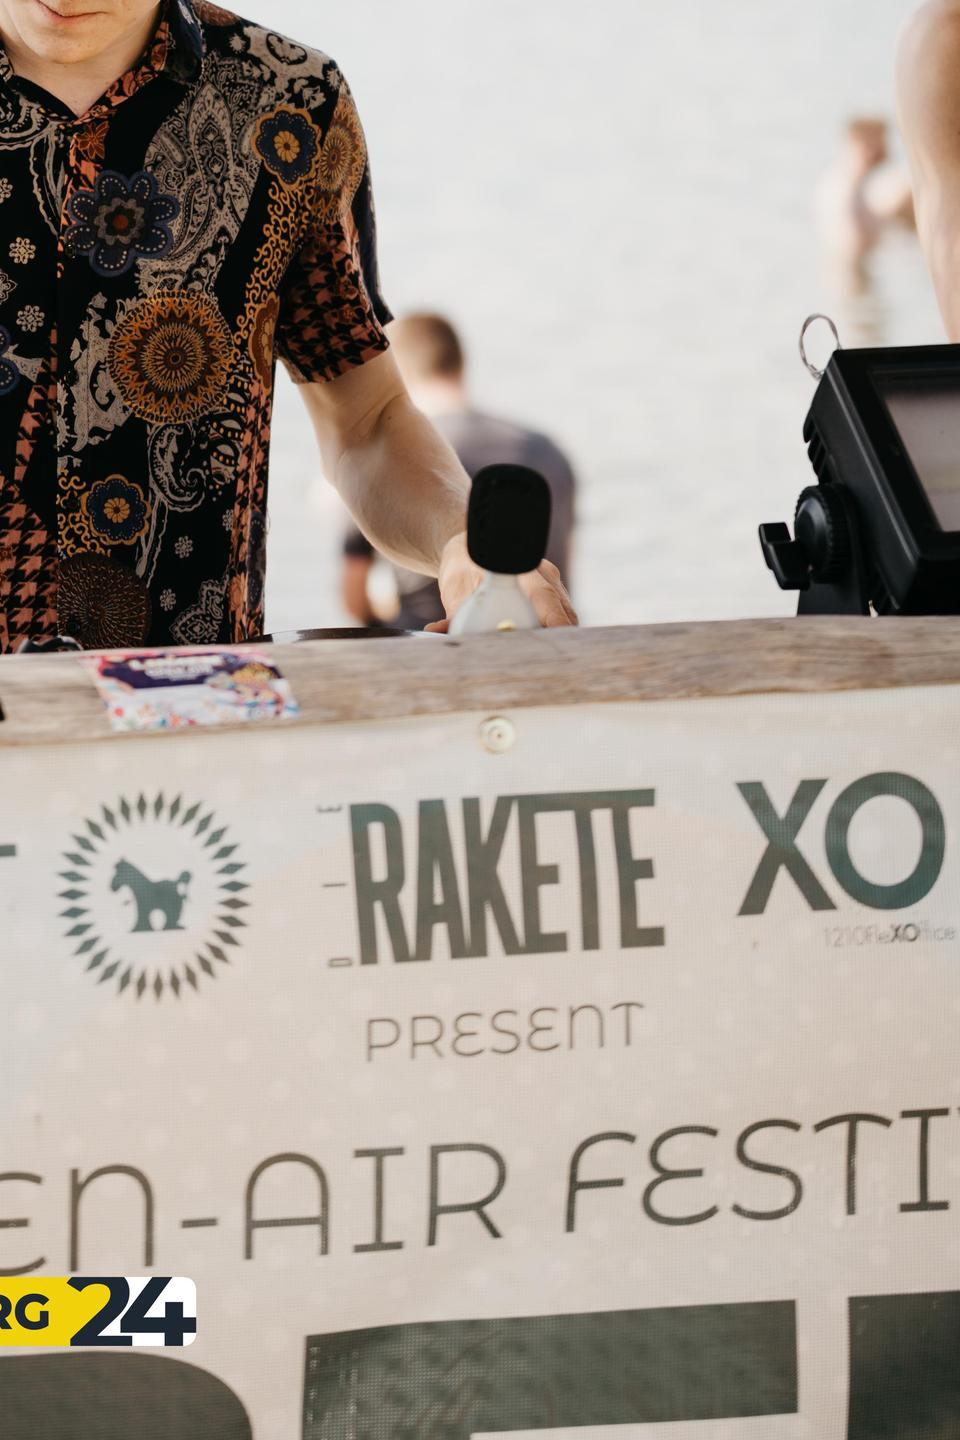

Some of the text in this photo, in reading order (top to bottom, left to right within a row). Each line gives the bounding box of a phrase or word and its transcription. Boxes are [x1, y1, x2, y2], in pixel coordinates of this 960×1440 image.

[349, 788, 665, 965] RAKETE
[735, 771, 946, 916] XO
[366, 1001, 644, 1061] PRESENT
[565, 1107, 960, 1233] FESTI
